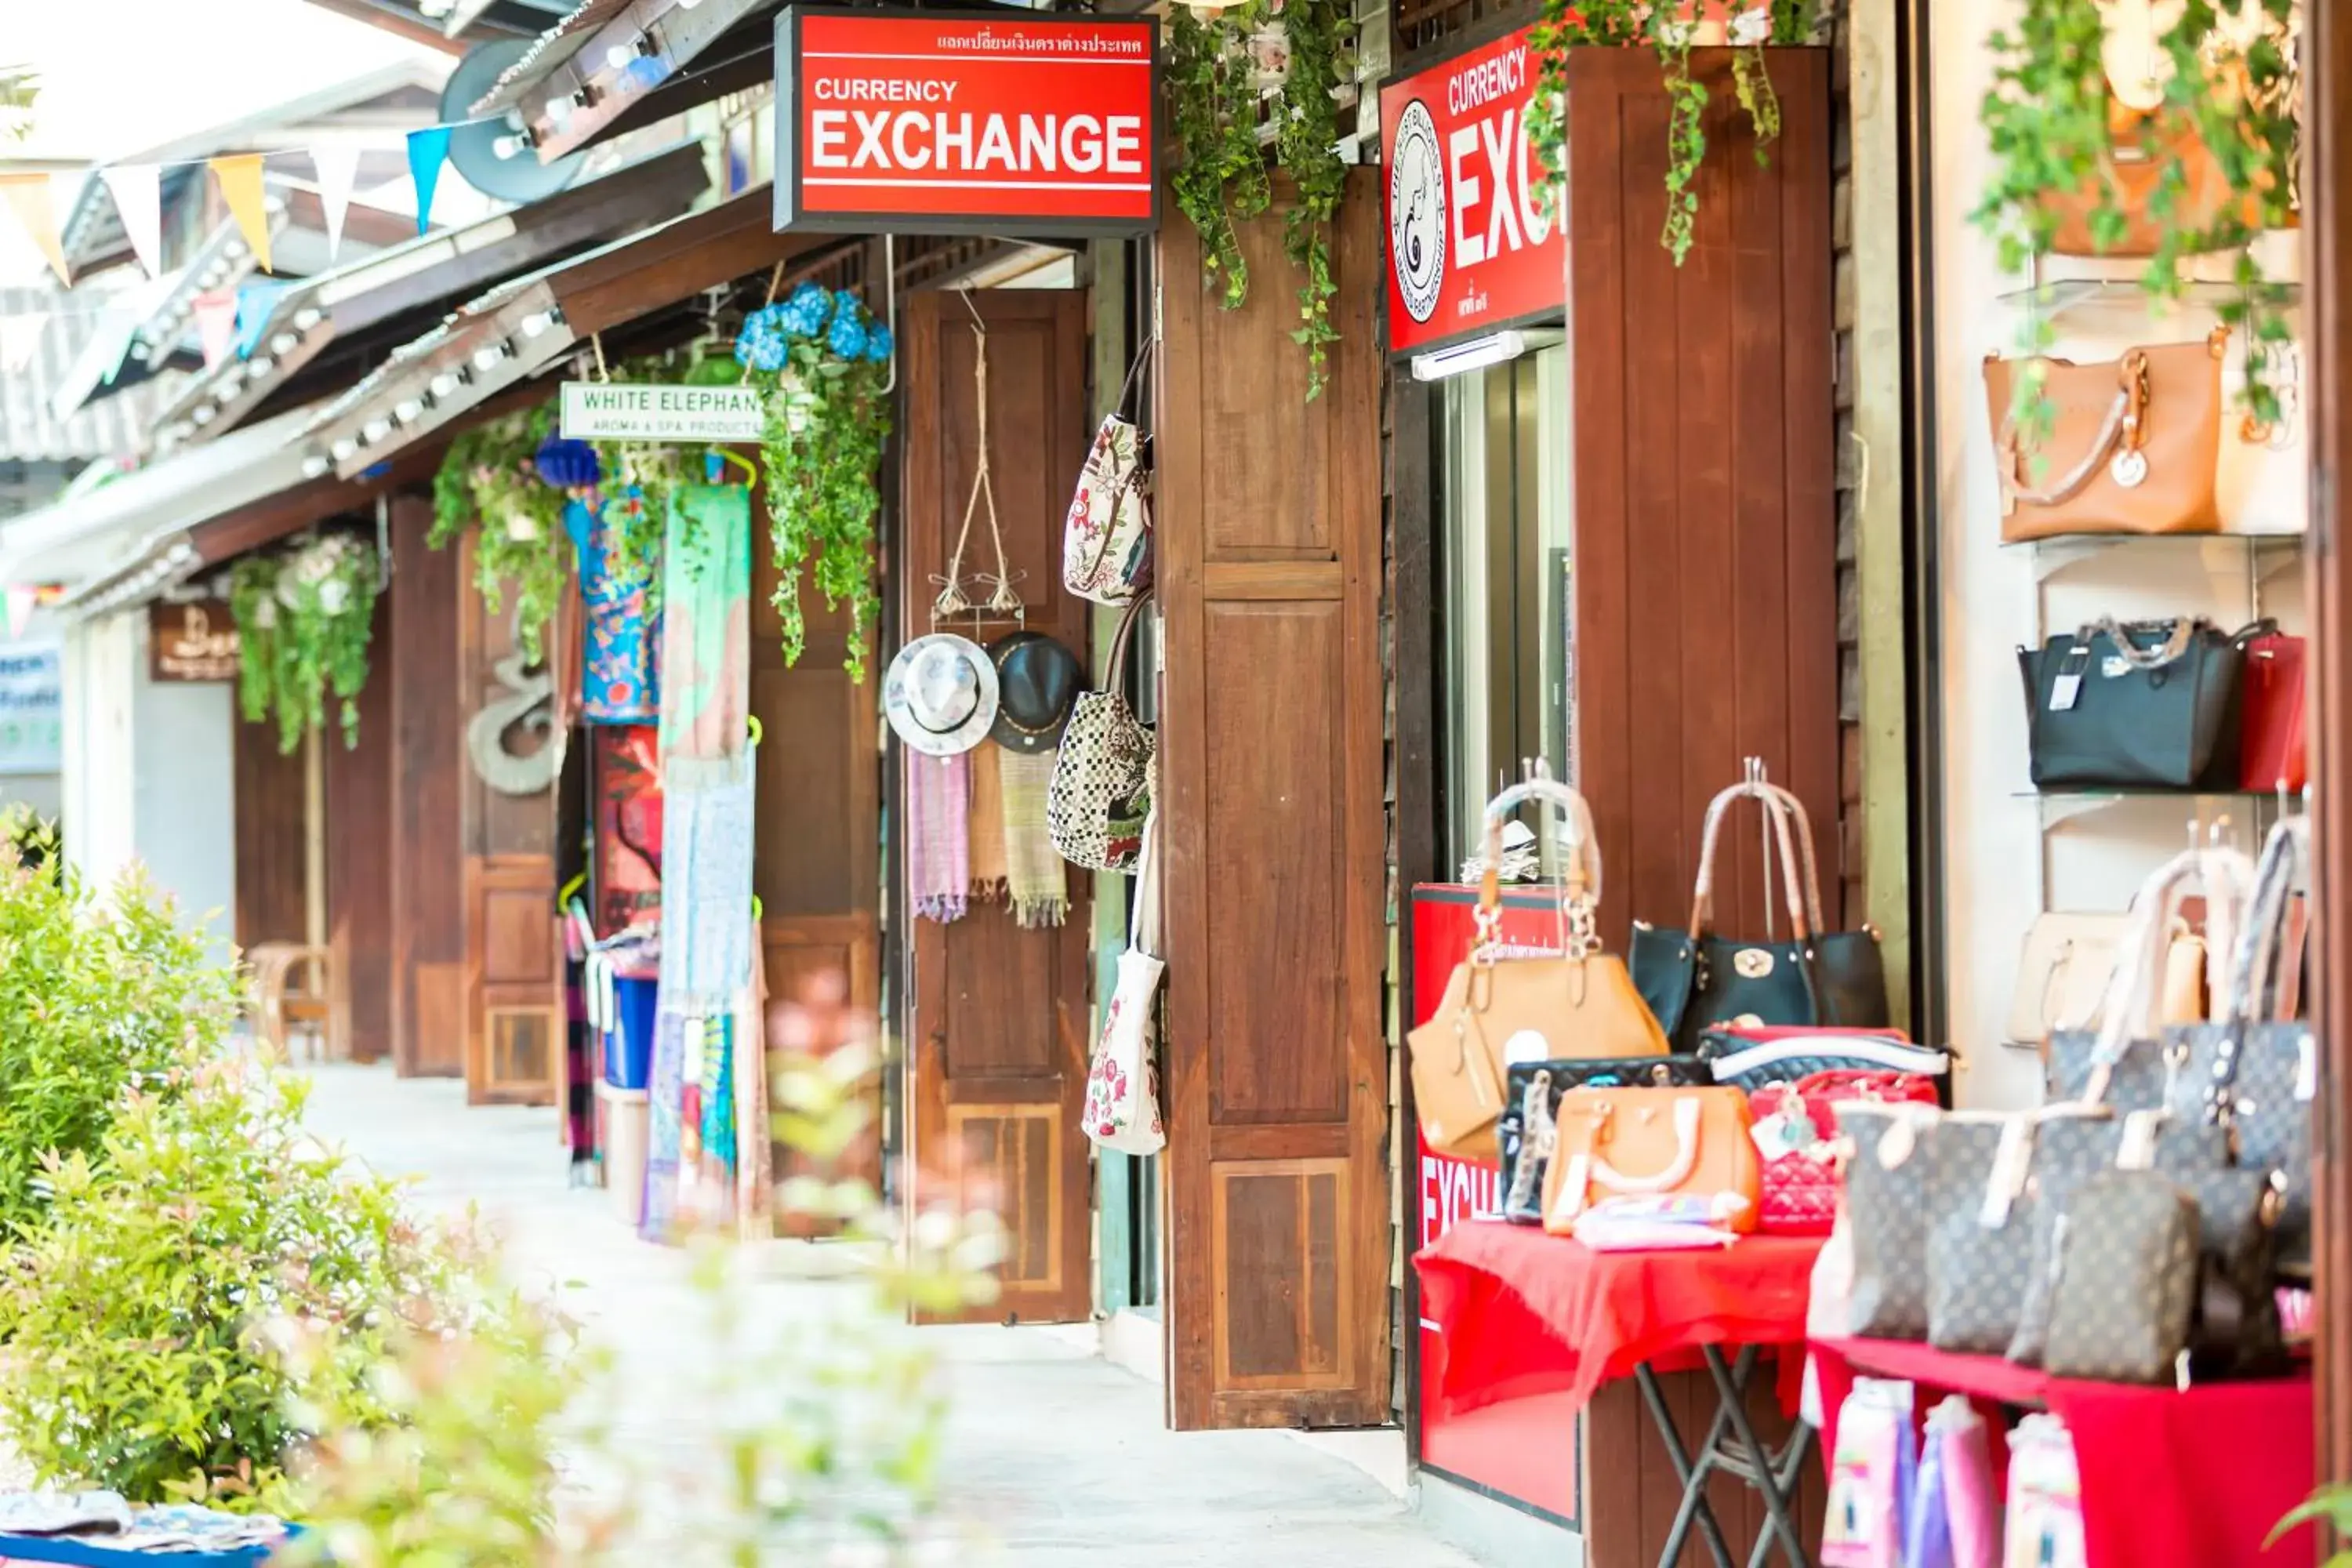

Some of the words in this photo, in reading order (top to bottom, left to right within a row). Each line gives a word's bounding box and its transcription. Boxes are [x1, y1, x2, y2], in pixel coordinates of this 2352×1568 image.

[815, 78, 957, 102] CURRENCY
[1449, 45, 1526, 117] CURRENCY
[811, 110, 1142, 173] EXCHANGE
[1449, 92, 1566, 270] EXC
[584, 391, 650, 410] WHITE
[661, 393, 758, 412] ELEPHAN
[593, 419, 638, 432] AROMA
[657, 421, 684, 432] SPA
